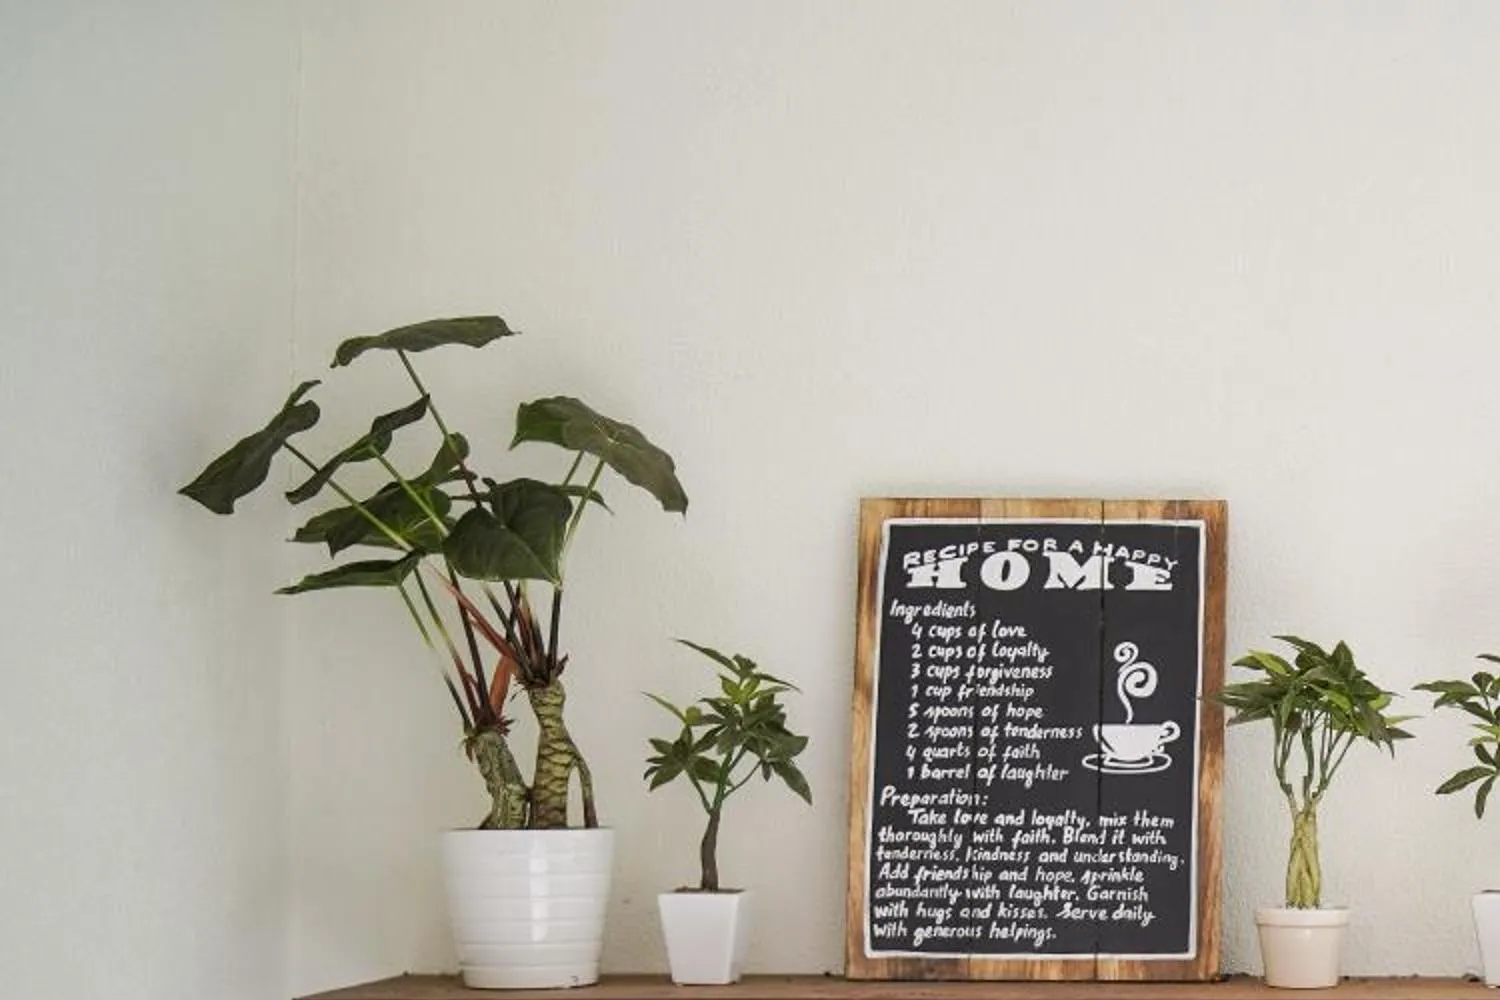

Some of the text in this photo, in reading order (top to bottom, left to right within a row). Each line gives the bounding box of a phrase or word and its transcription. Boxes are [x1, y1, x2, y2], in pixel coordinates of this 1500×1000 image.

[903, 538, 1178, 570] RECIPE FOR A HAPPY
[906, 551, 1173, 591] HOME
[890, 599, 977, 625] Ingredients
[912, 620, 1027, 643] 4 cups of love
[911, 641, 1050, 663] 2 cups of loyalty
[911, 663, 1054, 685] 3 cups forgiveness
[911, 684, 1035, 703] 1 cup friendship
[908, 702, 1043, 723] 5 spoons of hope
[908, 722, 1083, 743] 2 spoons of tenderness
[906, 741, 1040, 762] 4 quarts of faith
[921, 764, 970, 779] barrel
[977, 764, 997, 786] of
[1001, 763, 1069, 789] laughter
[879, 785, 988, 808] Preparation:
[908, 808, 947, 825] Take
[954, 808, 988, 825] love
[994, 809, 1025, 826] and
[1099, 812, 1127, 827] mix
[1134, 810, 1174, 828] them
[878, 825, 963, 849] thoroughly
[973, 828, 1003, 843] with
[1063, 827, 1106, 845] Blend
[1112, 829, 1125, 844] it
[1132, 830, 1167, 845] with
[965, 846, 1031, 863] kindness
[1039, 848, 1068, 863] and
[879, 862, 910, 879] Add
[913, 864, 992, 884] friendship
[998, 867, 1028, 881] and
[1080, 866, 1145, 885] sprinkle
[875, 883, 962, 905] abundantly
[966, 885, 1000, 899] with
[1087, 885, 1149, 902] Garnish
[874, 900, 908, 918] with
[916, 902, 952, 924] hugs
[960, 903, 992, 919] and
[1056, 902, 1108, 920] Serve
[913, 925, 982, 946] generous
[989, 921, 1056, 947] helpings.
